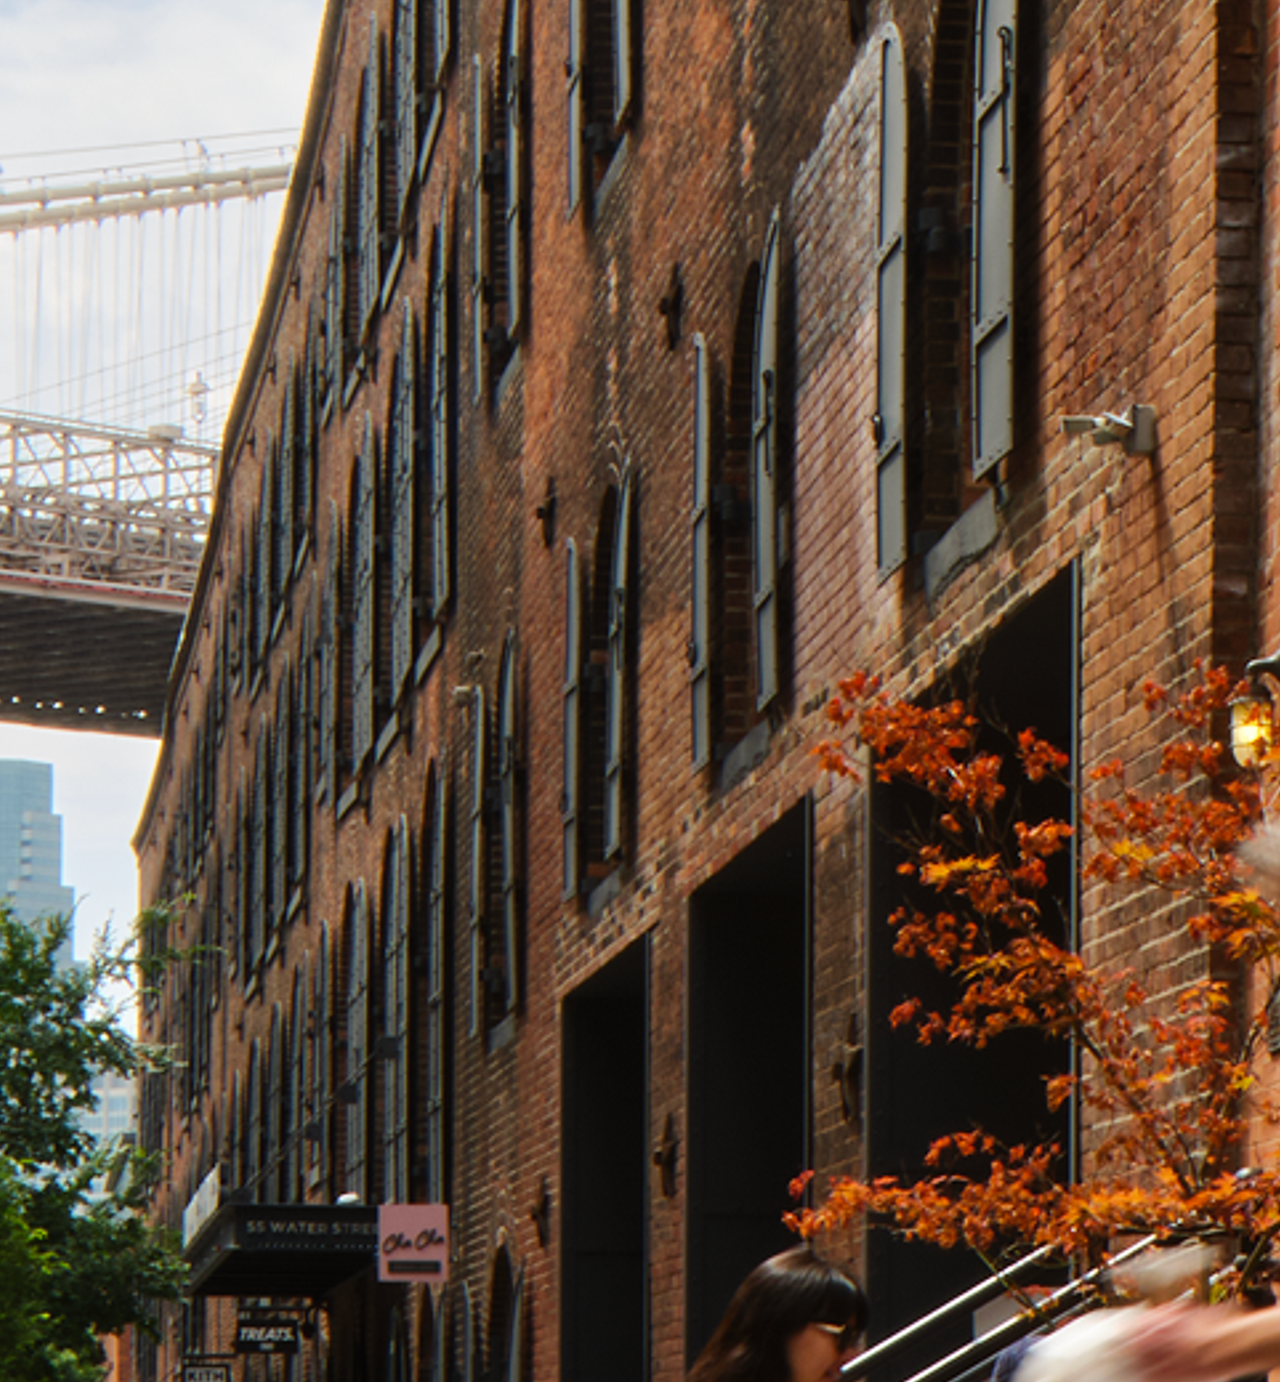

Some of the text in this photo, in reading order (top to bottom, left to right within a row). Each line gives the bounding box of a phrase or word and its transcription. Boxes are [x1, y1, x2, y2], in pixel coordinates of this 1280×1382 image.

[269, 1220, 328, 1235] WATER
[382, 1228, 445, 1255] Cha Cha
[187, 1369, 224, 1382] KITH
